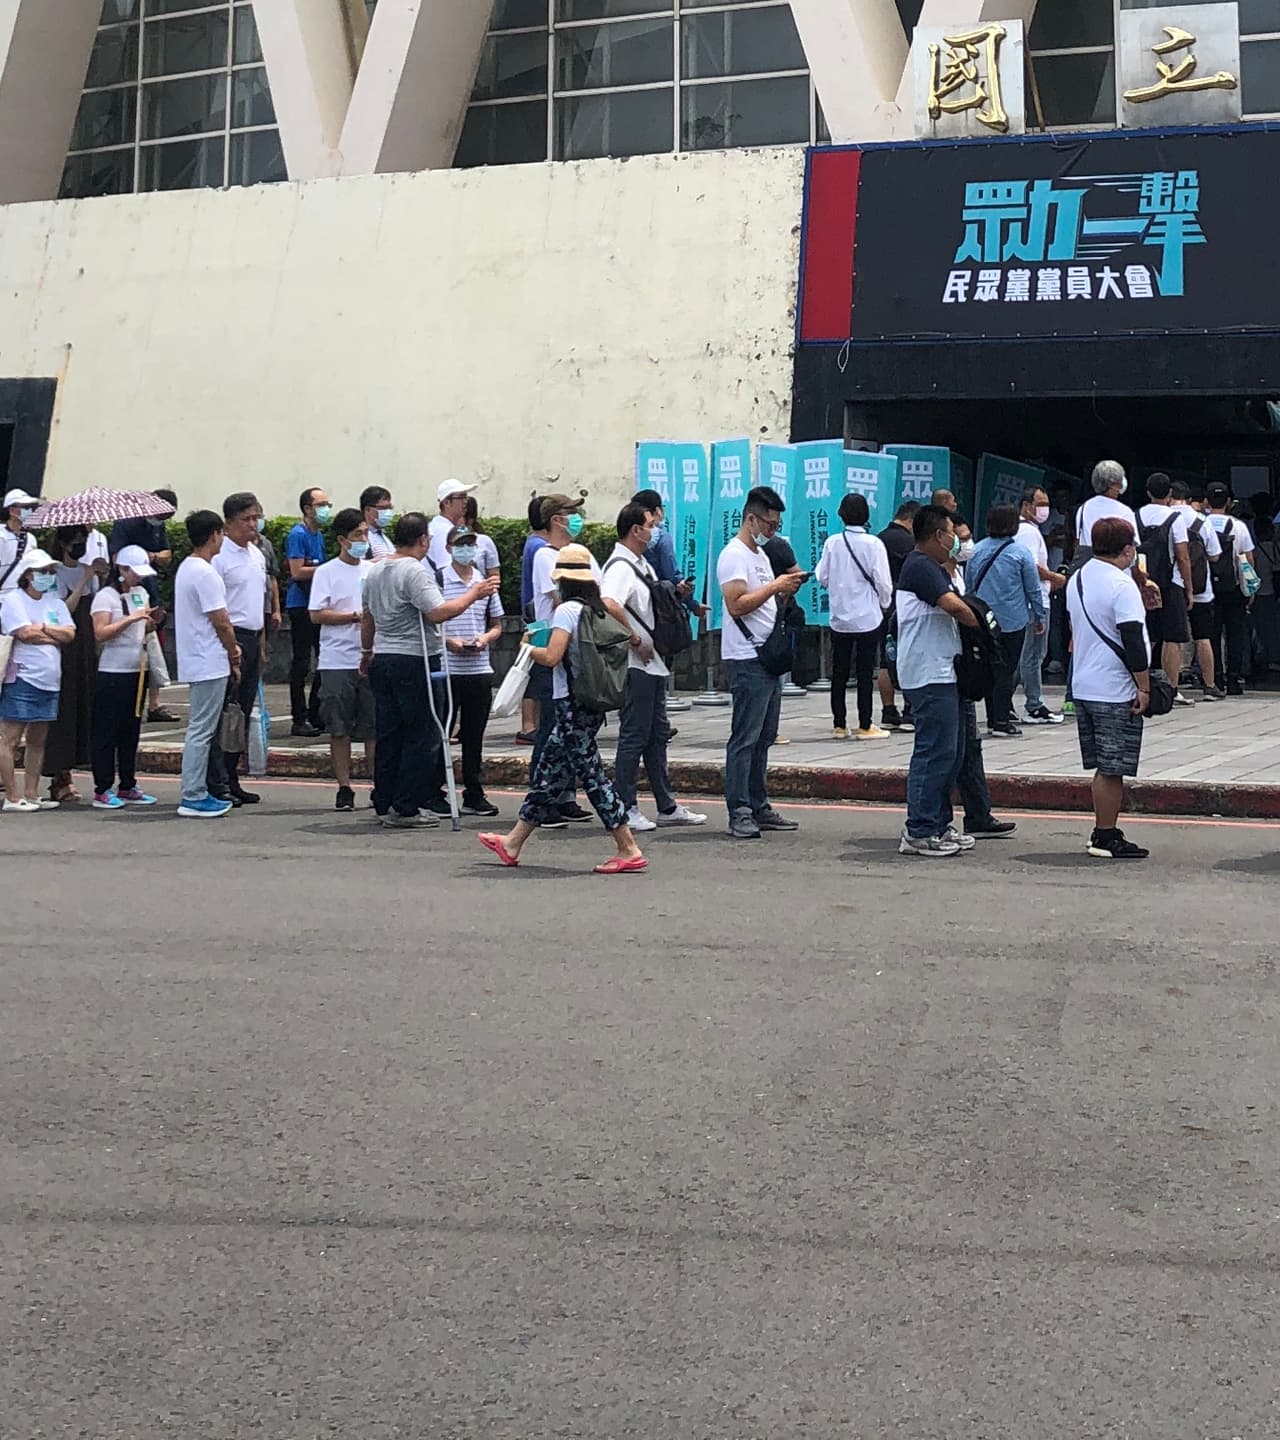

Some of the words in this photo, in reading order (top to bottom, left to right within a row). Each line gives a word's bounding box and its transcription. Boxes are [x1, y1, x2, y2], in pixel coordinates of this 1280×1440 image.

[941, 264, 1154, 303] 民眾黨黨員大會
